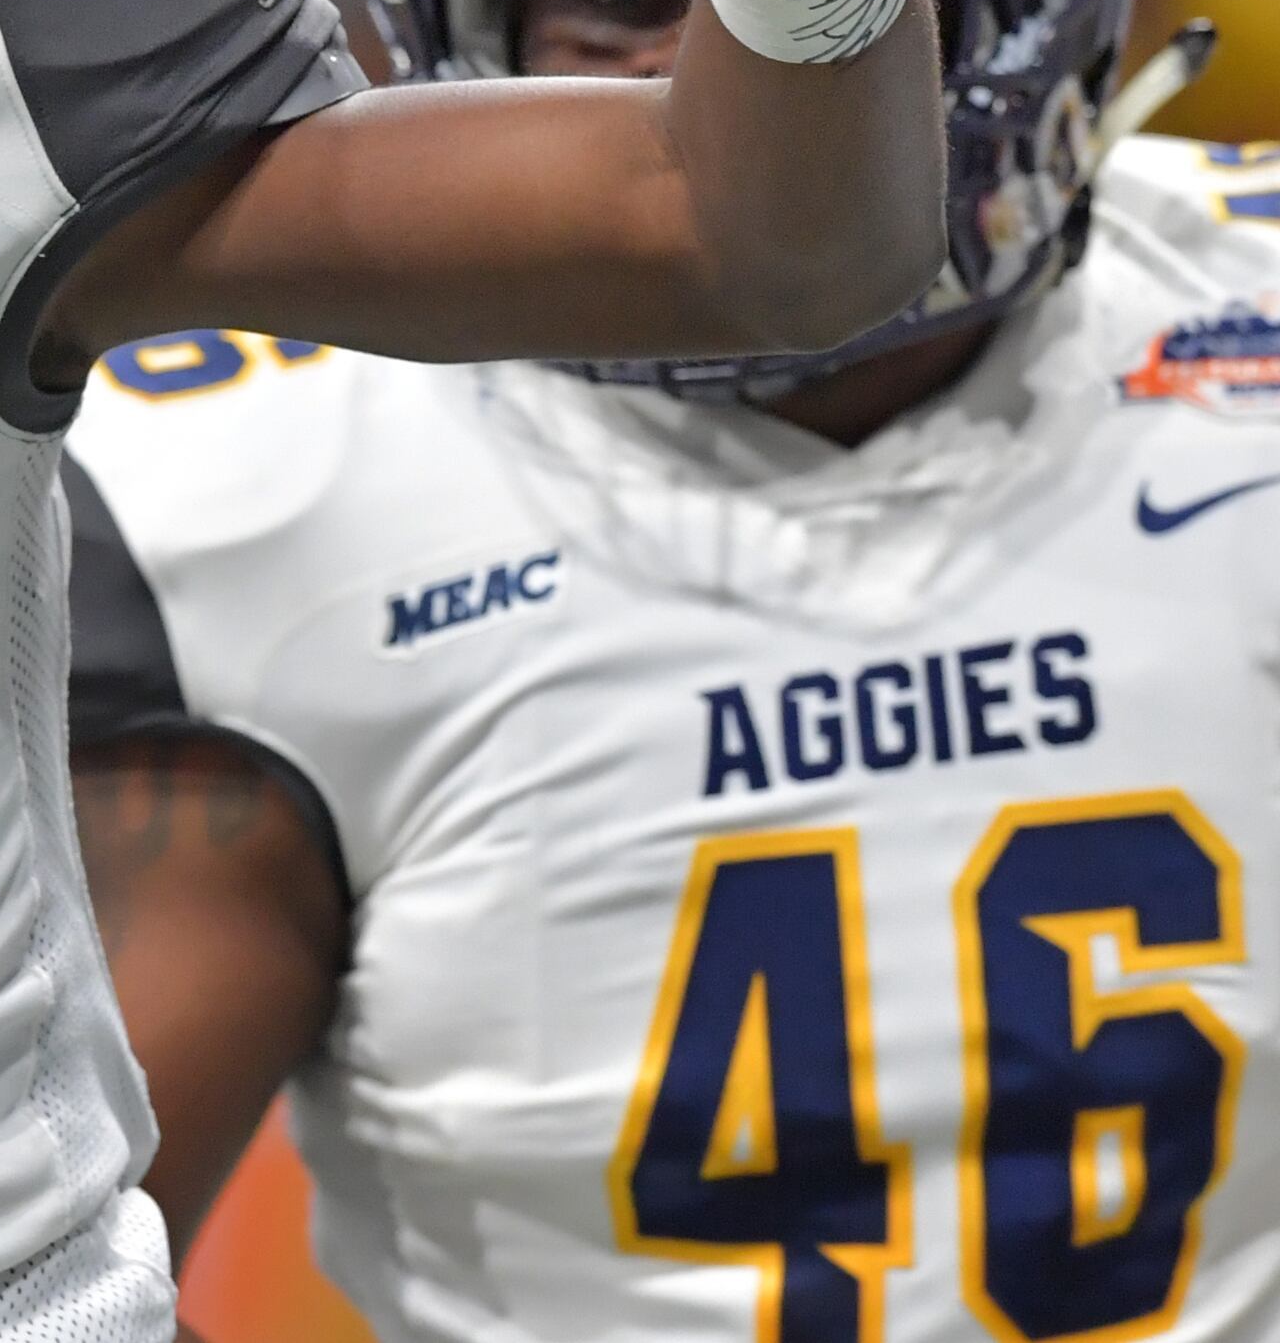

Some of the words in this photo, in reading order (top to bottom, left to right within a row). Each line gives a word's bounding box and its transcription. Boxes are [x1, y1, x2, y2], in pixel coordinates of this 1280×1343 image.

[384, 549, 561, 647] MEAC
[701, 631, 1099, 798] AGGIES
[607, 788, 1249, 1343] 46
